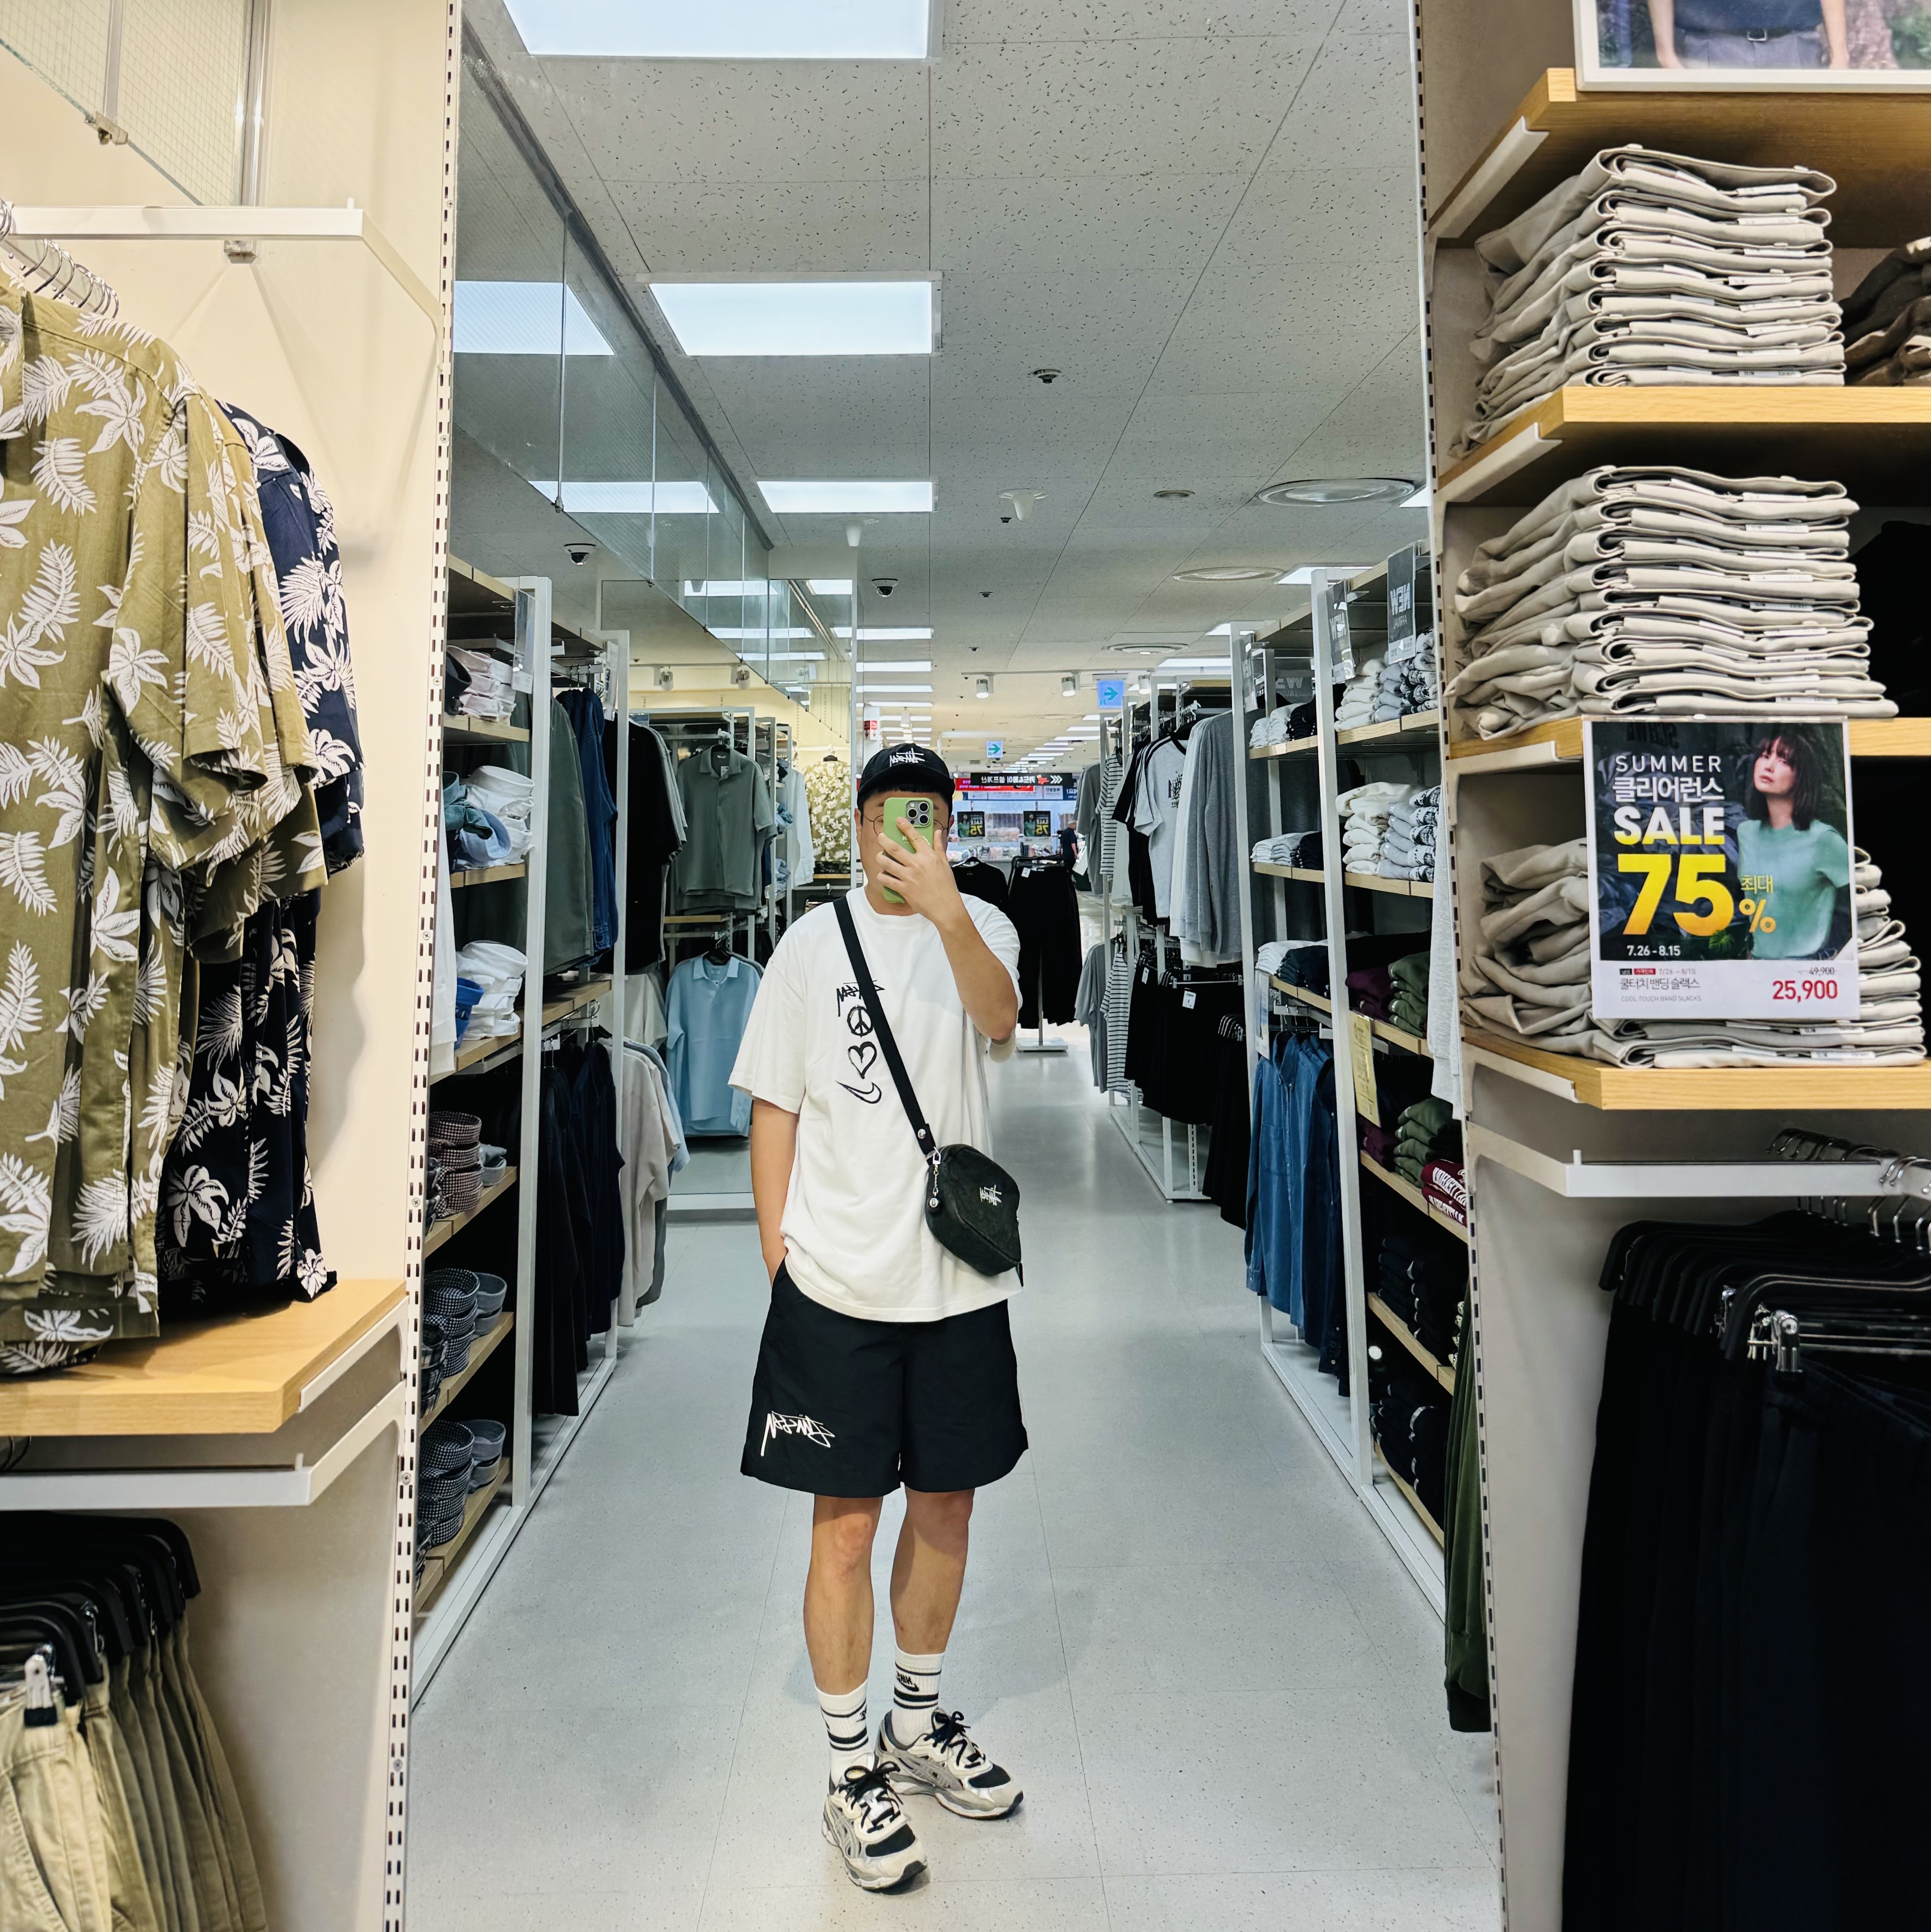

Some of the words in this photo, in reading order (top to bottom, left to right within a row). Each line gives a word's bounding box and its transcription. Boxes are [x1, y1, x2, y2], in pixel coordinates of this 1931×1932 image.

[1615, 755, 1721, 773] SUMMER
[1612, 777, 1725, 803] 클리어런스
[1613, 806, 1725, 845] SALE
[1740, 874, 1774, 894] 최대
[1619, 978, 1649, 990] 쿨터치
[1650, 978, 1669, 990] 밴딩
[1671, 978, 1700, 990] 슬랙스
[1772, 980, 1838, 1003] 25,900
